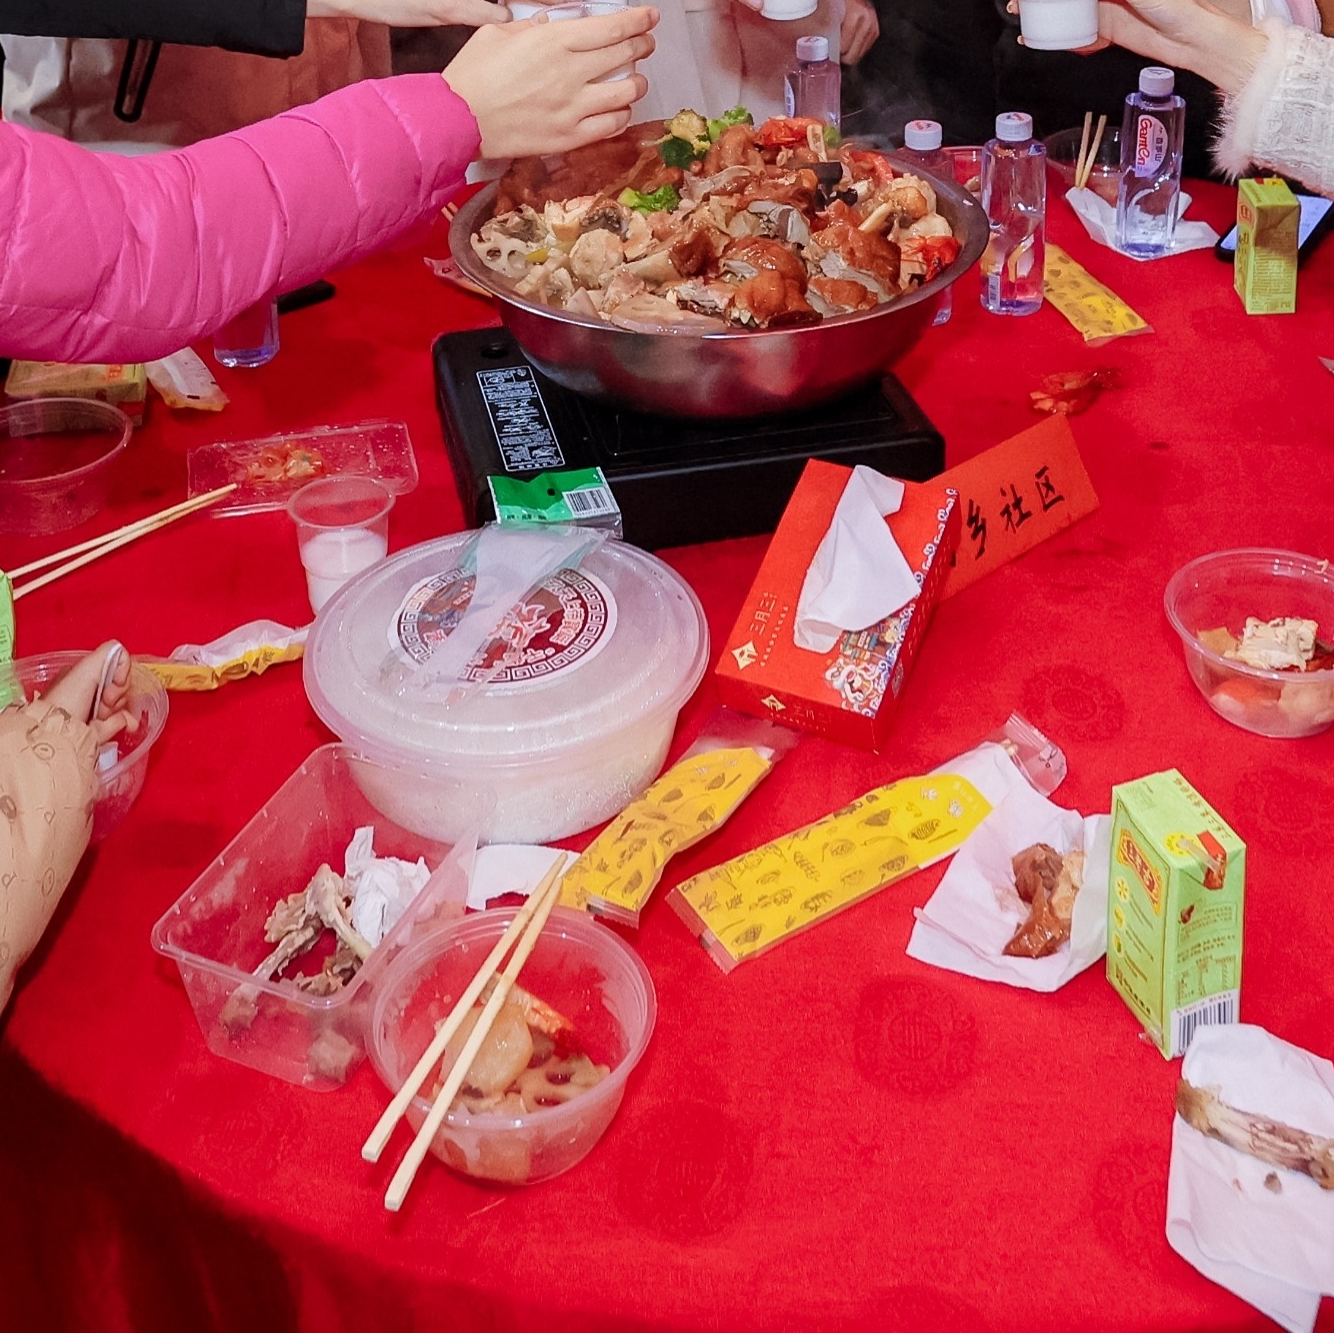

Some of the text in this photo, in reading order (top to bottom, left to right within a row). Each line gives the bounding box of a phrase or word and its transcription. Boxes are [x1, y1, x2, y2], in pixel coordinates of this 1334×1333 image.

[950, 465, 1064, 567] 乡社区
[750, 593, 775, 635] 三月三
